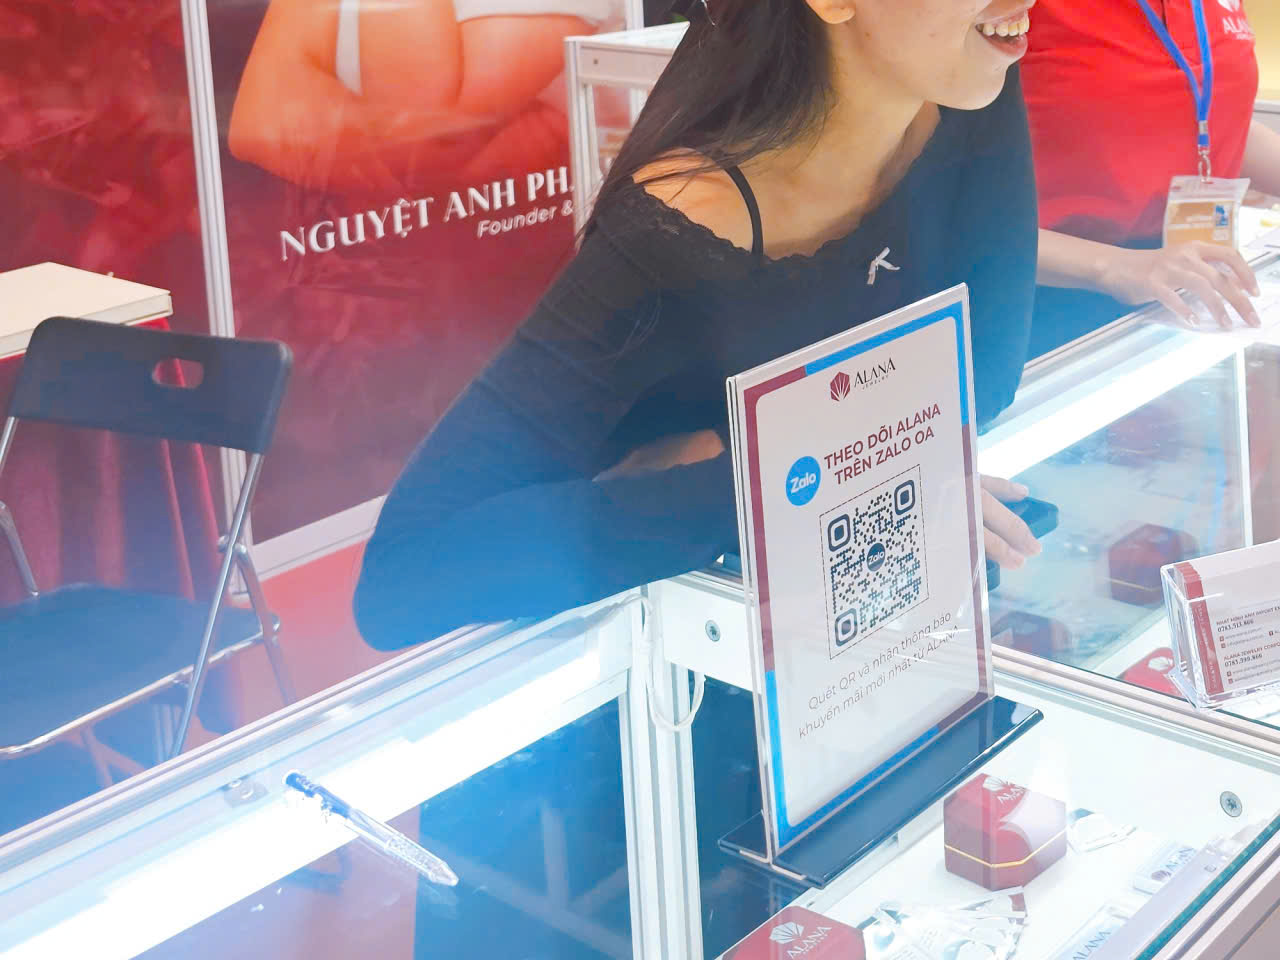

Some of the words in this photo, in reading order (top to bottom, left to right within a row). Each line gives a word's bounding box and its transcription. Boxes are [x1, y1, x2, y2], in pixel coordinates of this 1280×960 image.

[280, 196, 435, 262] NGUYỆT
[443, 177, 516, 223] ANH
[526, 165, 576, 202] PH
[476, 202, 558, 239] Founder
[560, 199, 574, 217] &
[853, 357, 896, 388] ALANA
[823, 440, 864, 470] THEO
[867, 425, 893, 450] DÕI
[895, 403, 941, 436] ALANA
[834, 455, 873, 485] TRÊN
[875, 437, 911, 466] ZALO
[914, 426, 935, 445] OA
[789, 471, 817, 494] Zalo
[798, 704, 841, 739] khuyến
[843, 690, 864, 711] mãi
[865, 674, 887, 696] mới
[888, 658, 912, 682] nhất
[926, 625, 960, 656] ALANA
[808, 685, 837, 711] Quét
[839, 671, 857, 691] QR
[857, 663, 870, 680] và
[872, 646, 899, 671] nhận
[900, 624, 931, 649] thông
[933, 611, 951, 632] báo
[786, 925, 832, 959] ALANA
